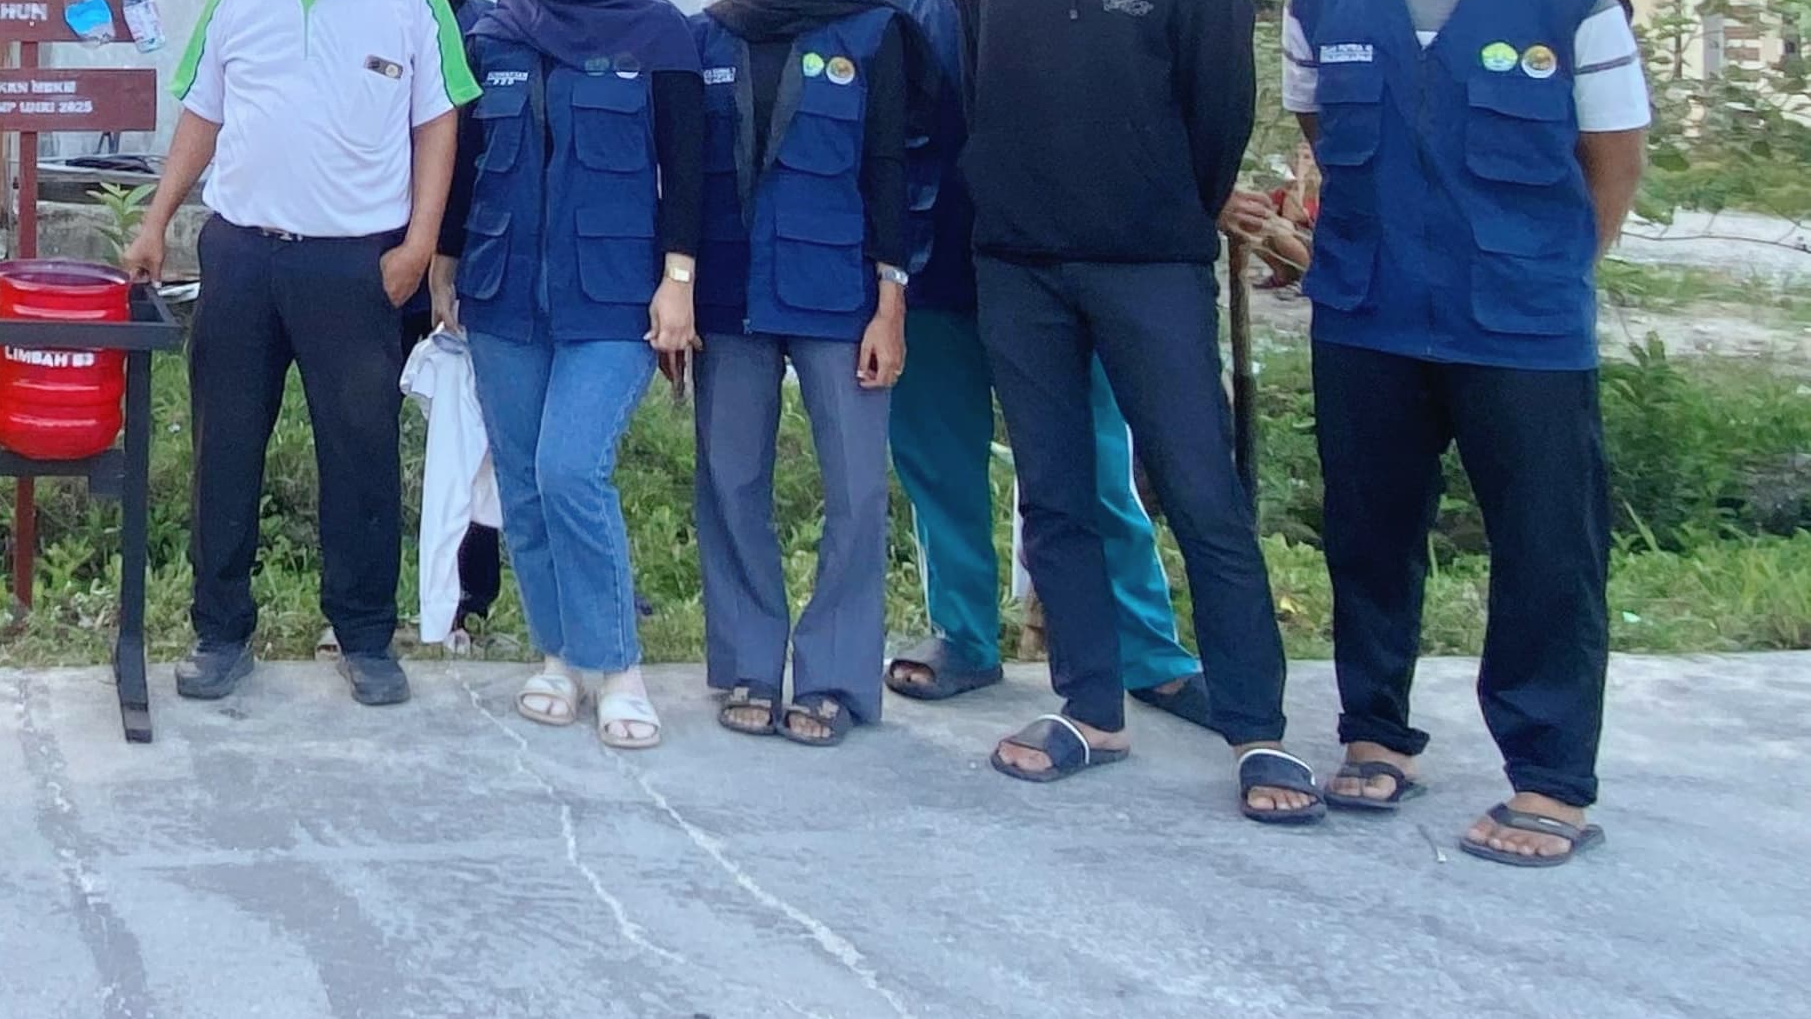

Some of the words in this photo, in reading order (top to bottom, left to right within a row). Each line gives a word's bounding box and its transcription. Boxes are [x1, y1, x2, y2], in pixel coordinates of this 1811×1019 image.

[31, 80, 76, 94] MBKM
[19, 101, 55, 113] UNRI
[4, 345, 68, 368] LIMBAH
[72, 352, 94, 368] B3
